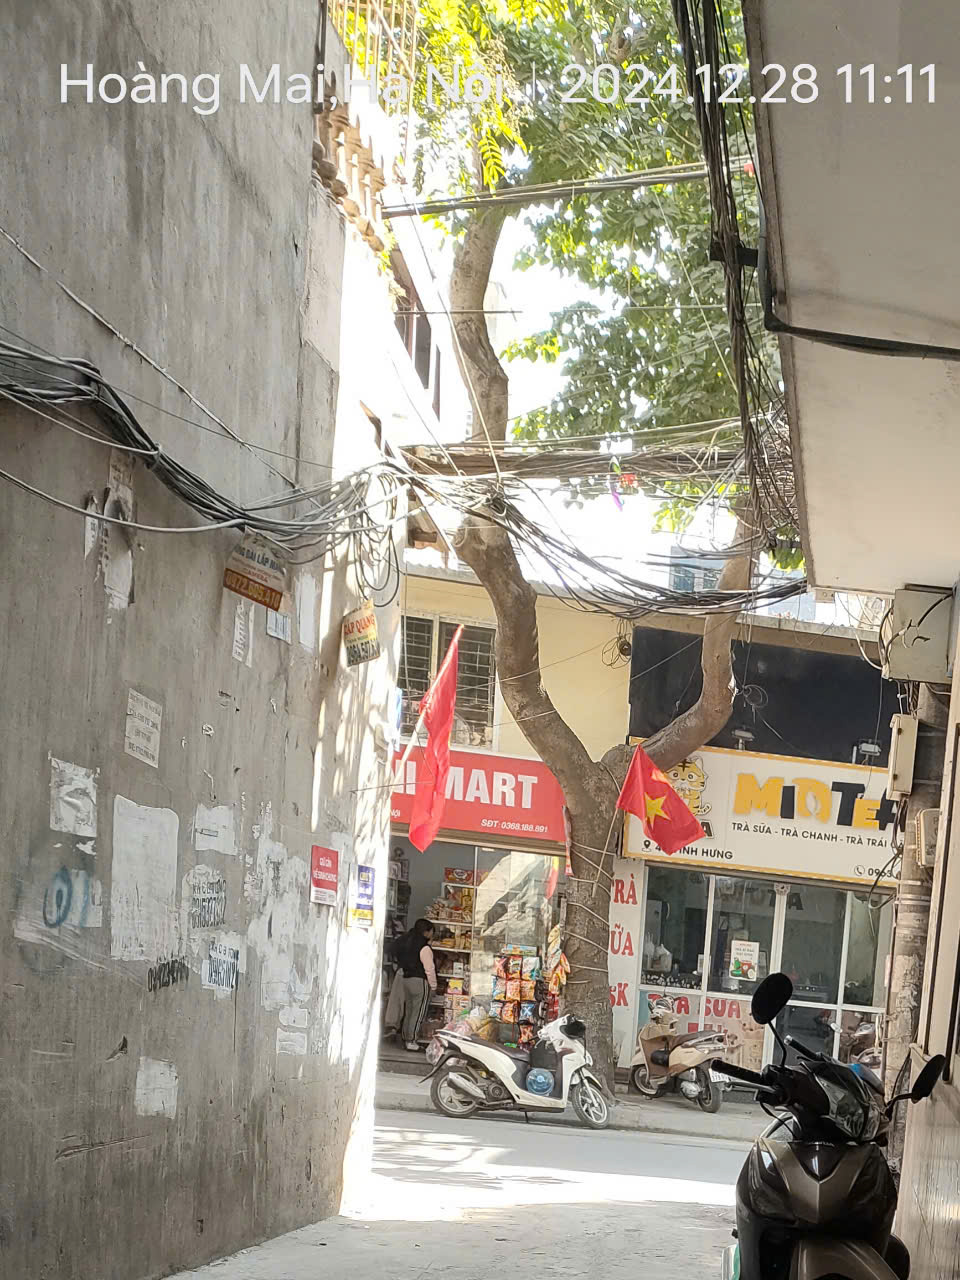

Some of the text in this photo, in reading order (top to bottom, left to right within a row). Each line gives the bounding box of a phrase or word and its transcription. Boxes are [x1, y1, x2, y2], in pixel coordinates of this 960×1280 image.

[444, 766, 538, 809] MART
[732, 821, 750, 833] TRÀ
[753, 823, 772, 835] SỮA
[781, 827, 799, 838] TRÀ
[801, 830, 838, 843] CHANH
[846, 834, 864, 846] TRÀ
[867, 836, 887, 848] TRÁI
[701, 847, 733, 860] HƯNG
